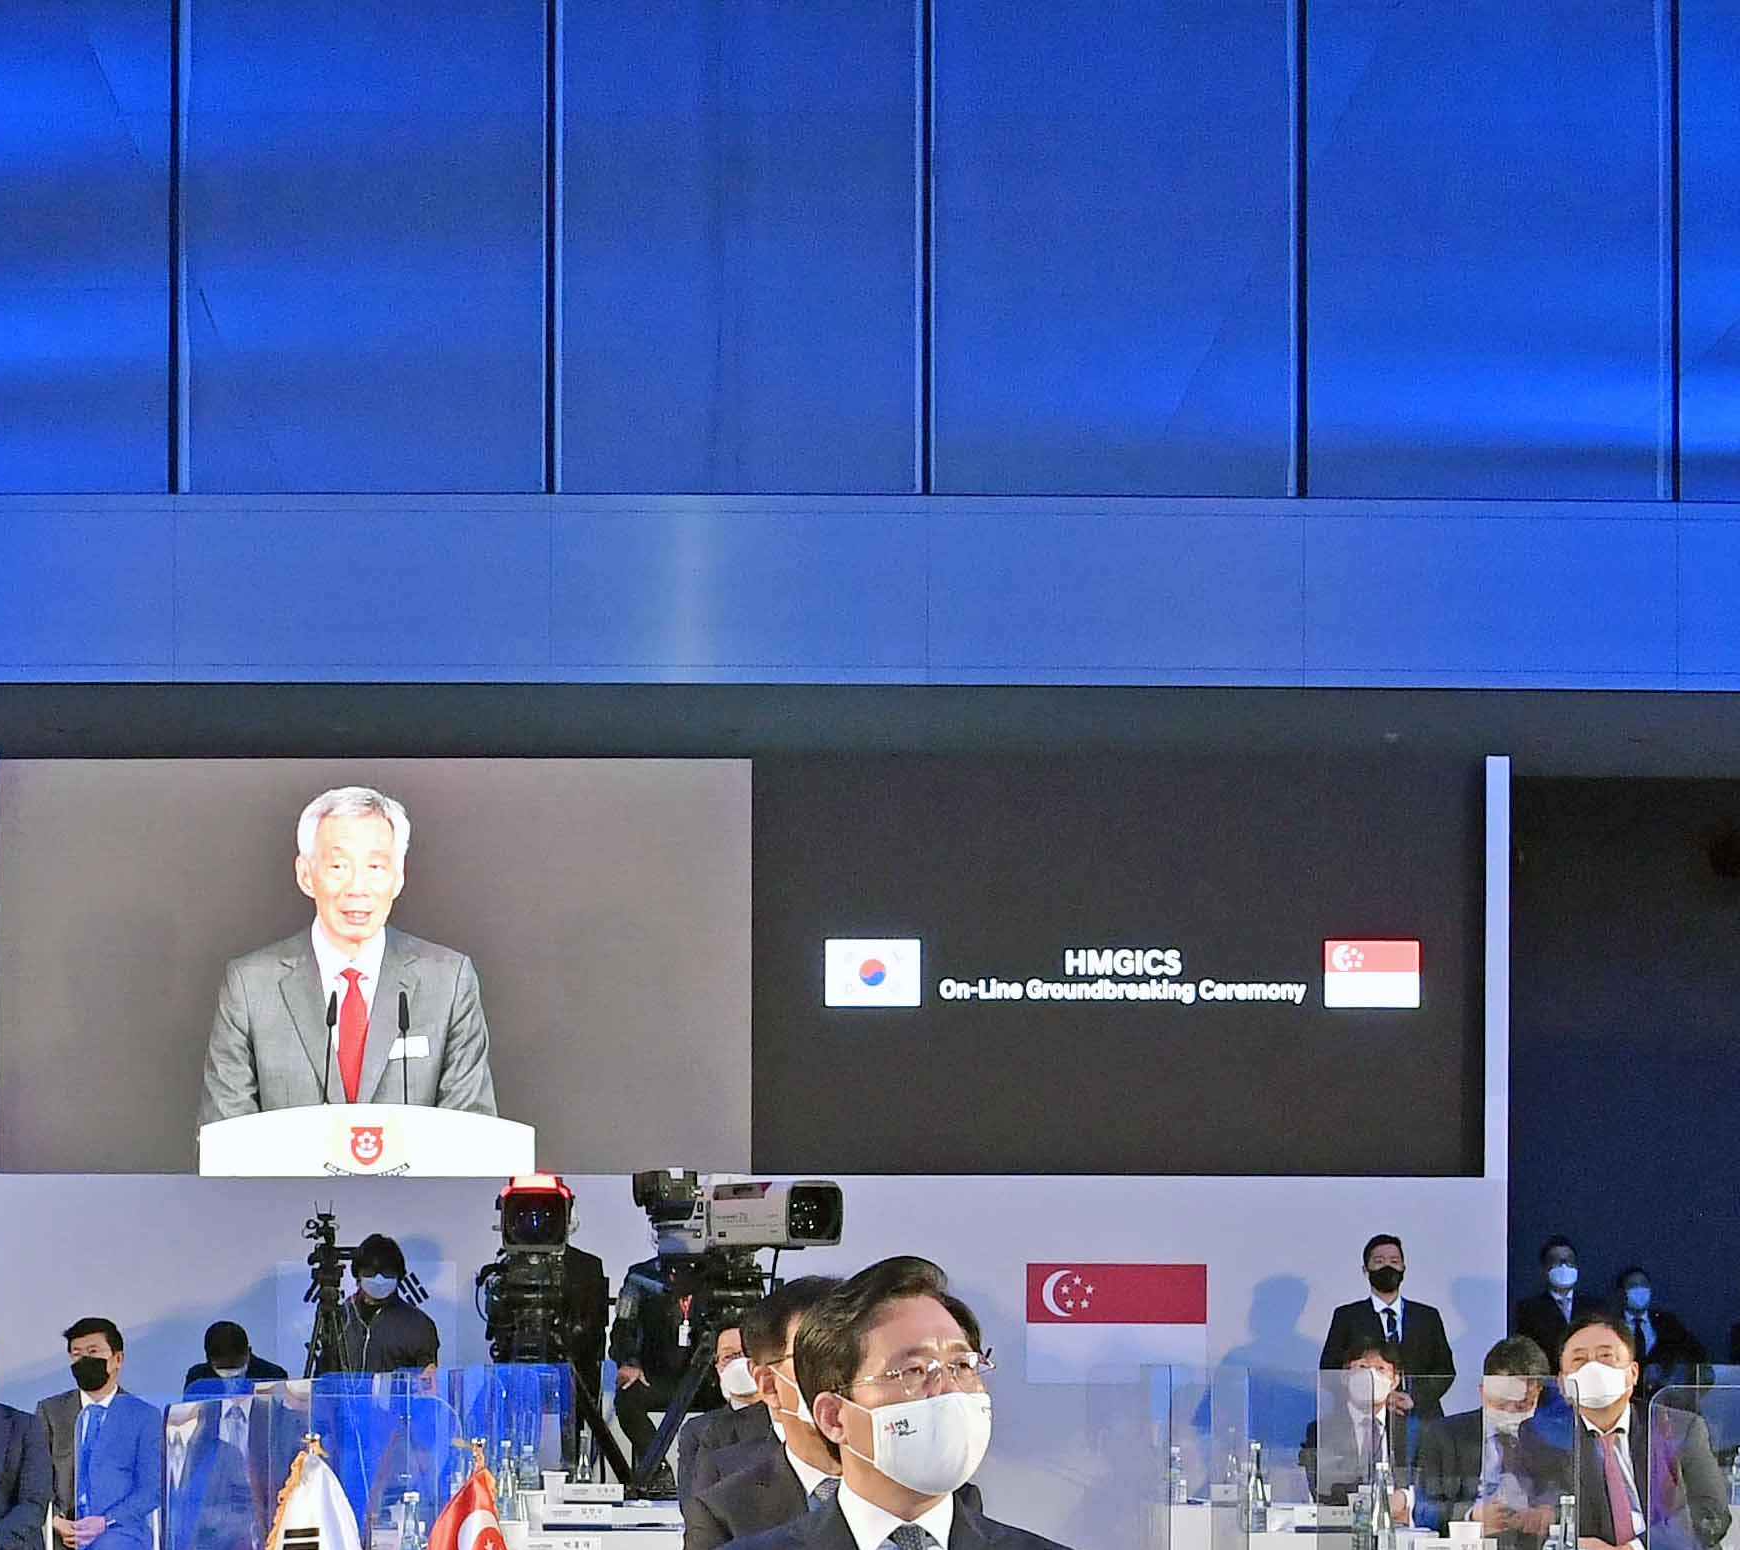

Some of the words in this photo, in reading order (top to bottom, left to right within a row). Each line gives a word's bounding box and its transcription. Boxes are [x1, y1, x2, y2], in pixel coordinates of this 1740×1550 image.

[1064, 949, 1182, 975] HMGICS
[939, 978, 1023, 1000] On-Line
[1025, 979, 1196, 1004] Groundbreaking
[1198, 979, 1307, 1004] Ceremony
